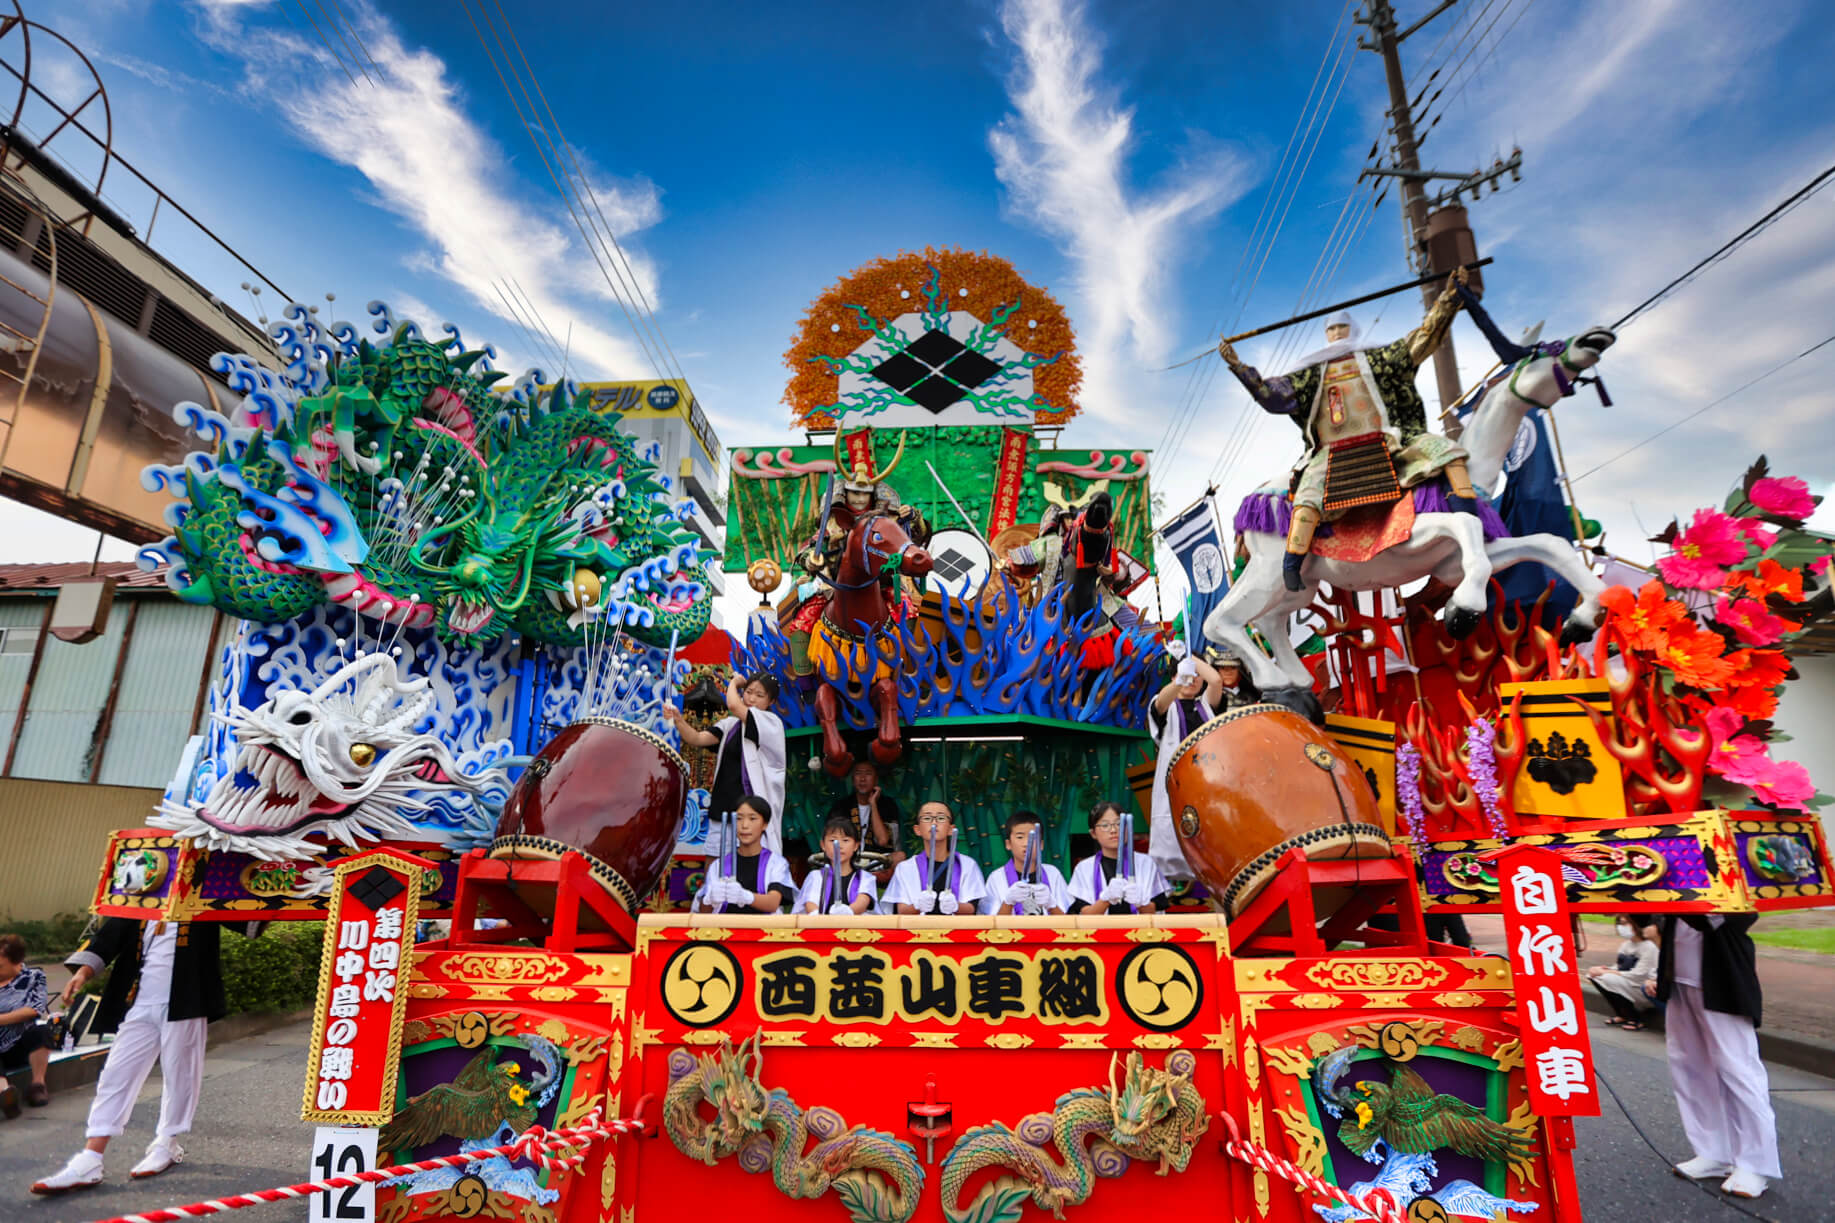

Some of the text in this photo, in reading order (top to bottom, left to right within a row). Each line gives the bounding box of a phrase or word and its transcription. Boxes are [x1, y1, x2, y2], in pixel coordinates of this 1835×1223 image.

[363, 907, 404, 1003] 第四次
[760, 954, 1101, 1019] 西茜山車組
[1511, 865, 1589, 1100] 自作山車
[315, 1143, 366, 1220] 12
